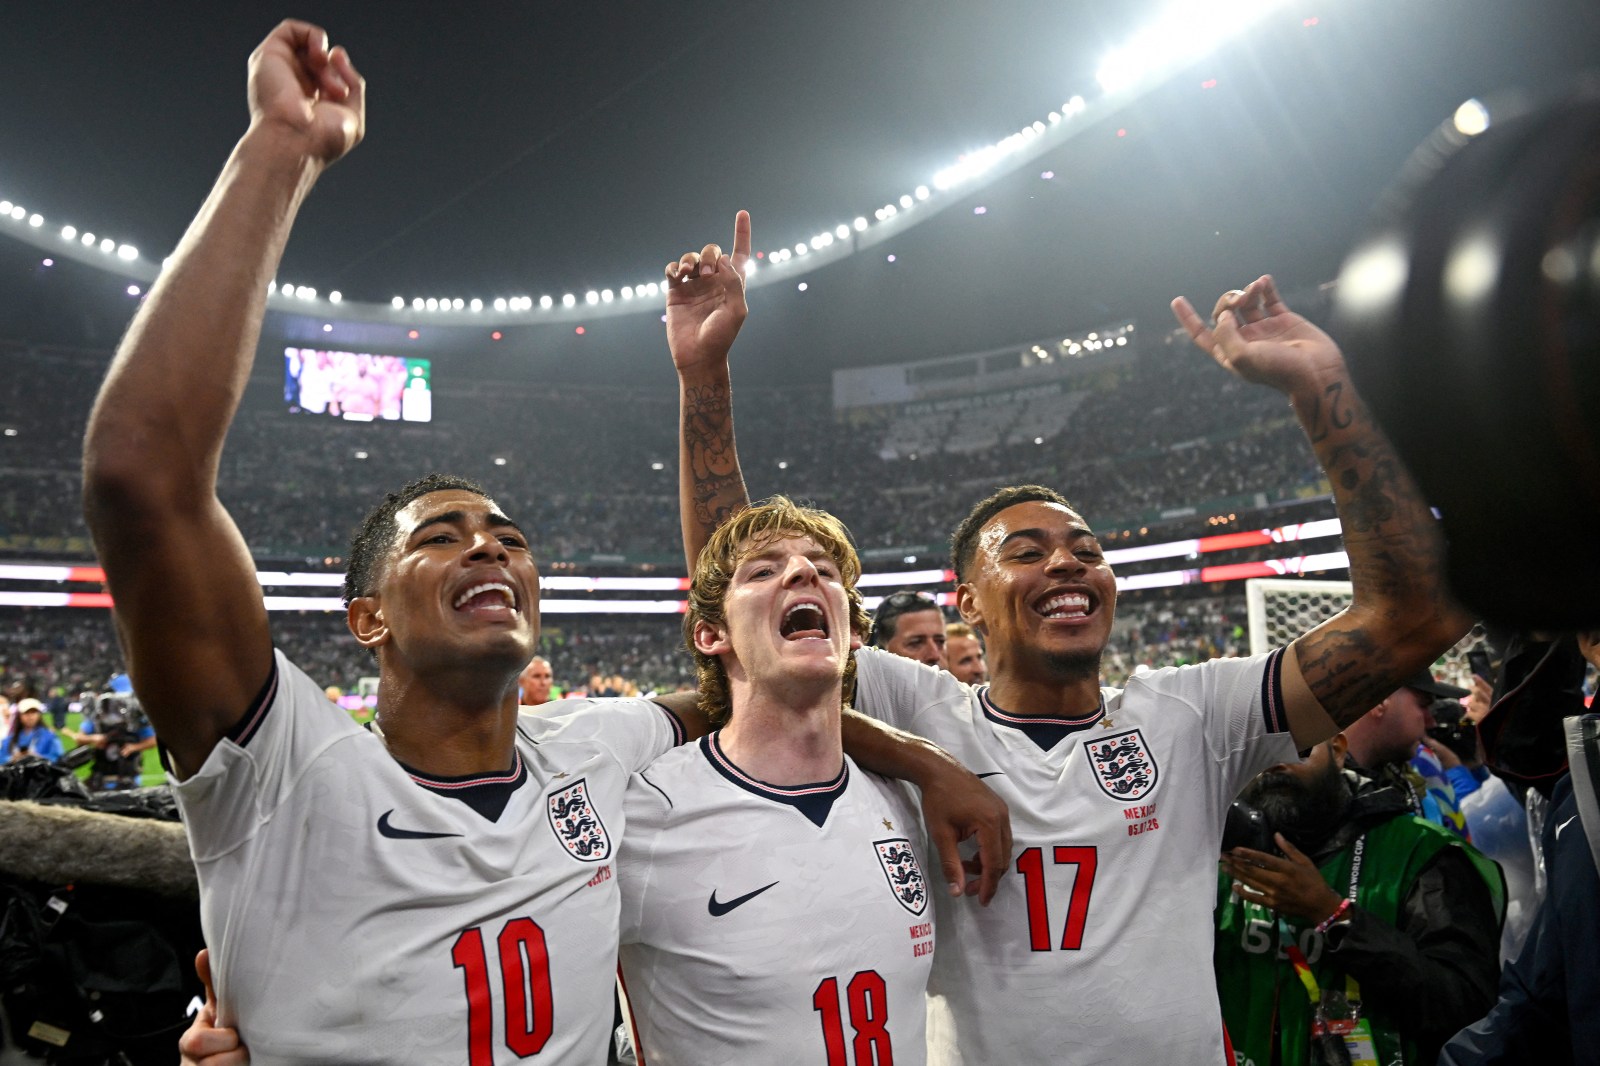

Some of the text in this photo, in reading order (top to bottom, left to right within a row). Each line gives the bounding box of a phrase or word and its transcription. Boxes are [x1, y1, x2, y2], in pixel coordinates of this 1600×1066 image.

[1123, 803, 1156, 820] MEXICO
[1354, 839, 1364, 855] CUP
[1350, 855, 1362, 884] WORLD
[1016, 846, 1098, 952] 17
[909, 922, 932, 940] MEXICO
[451, 916, 554, 1066] 10
[812, 969, 894, 1066] 18
